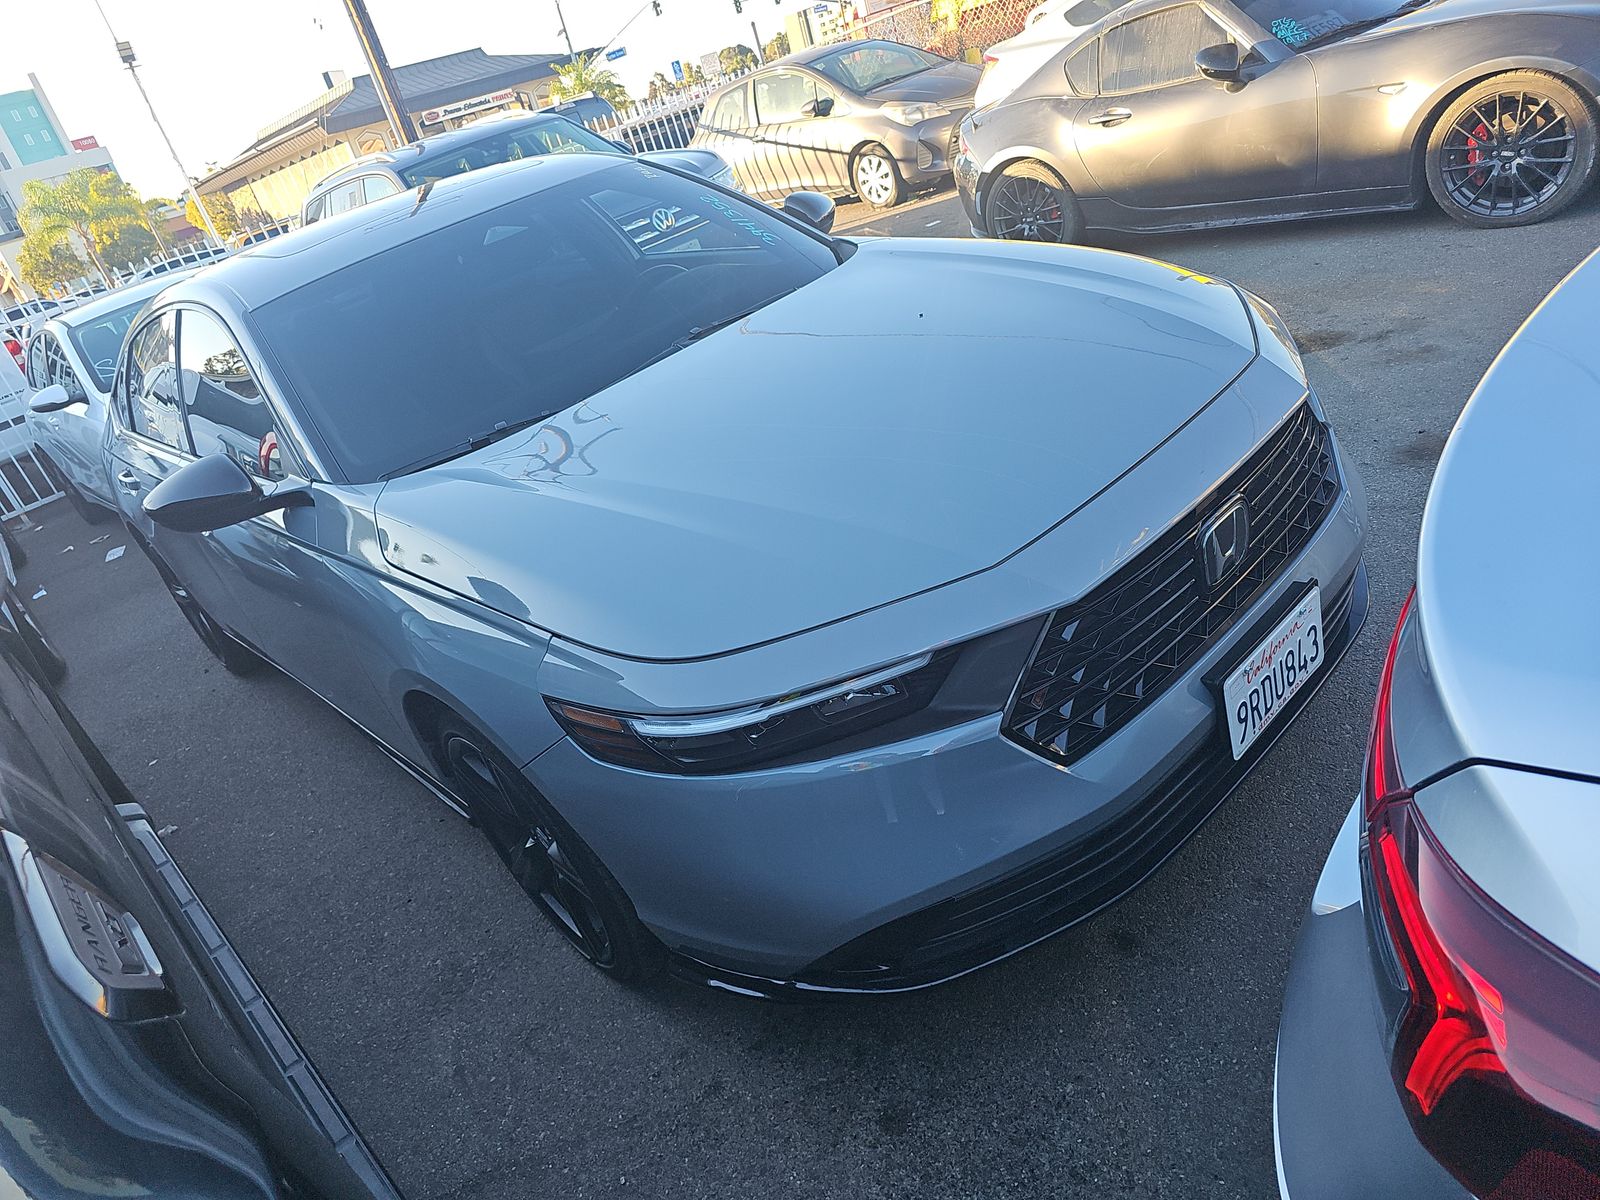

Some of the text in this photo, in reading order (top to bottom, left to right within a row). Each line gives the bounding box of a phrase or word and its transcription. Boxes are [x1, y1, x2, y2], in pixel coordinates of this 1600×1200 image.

[1237, 623, 1320, 745] 9RDU843
[1245, 620, 1305, 684] California
[59, 873, 114, 977] RANGER
